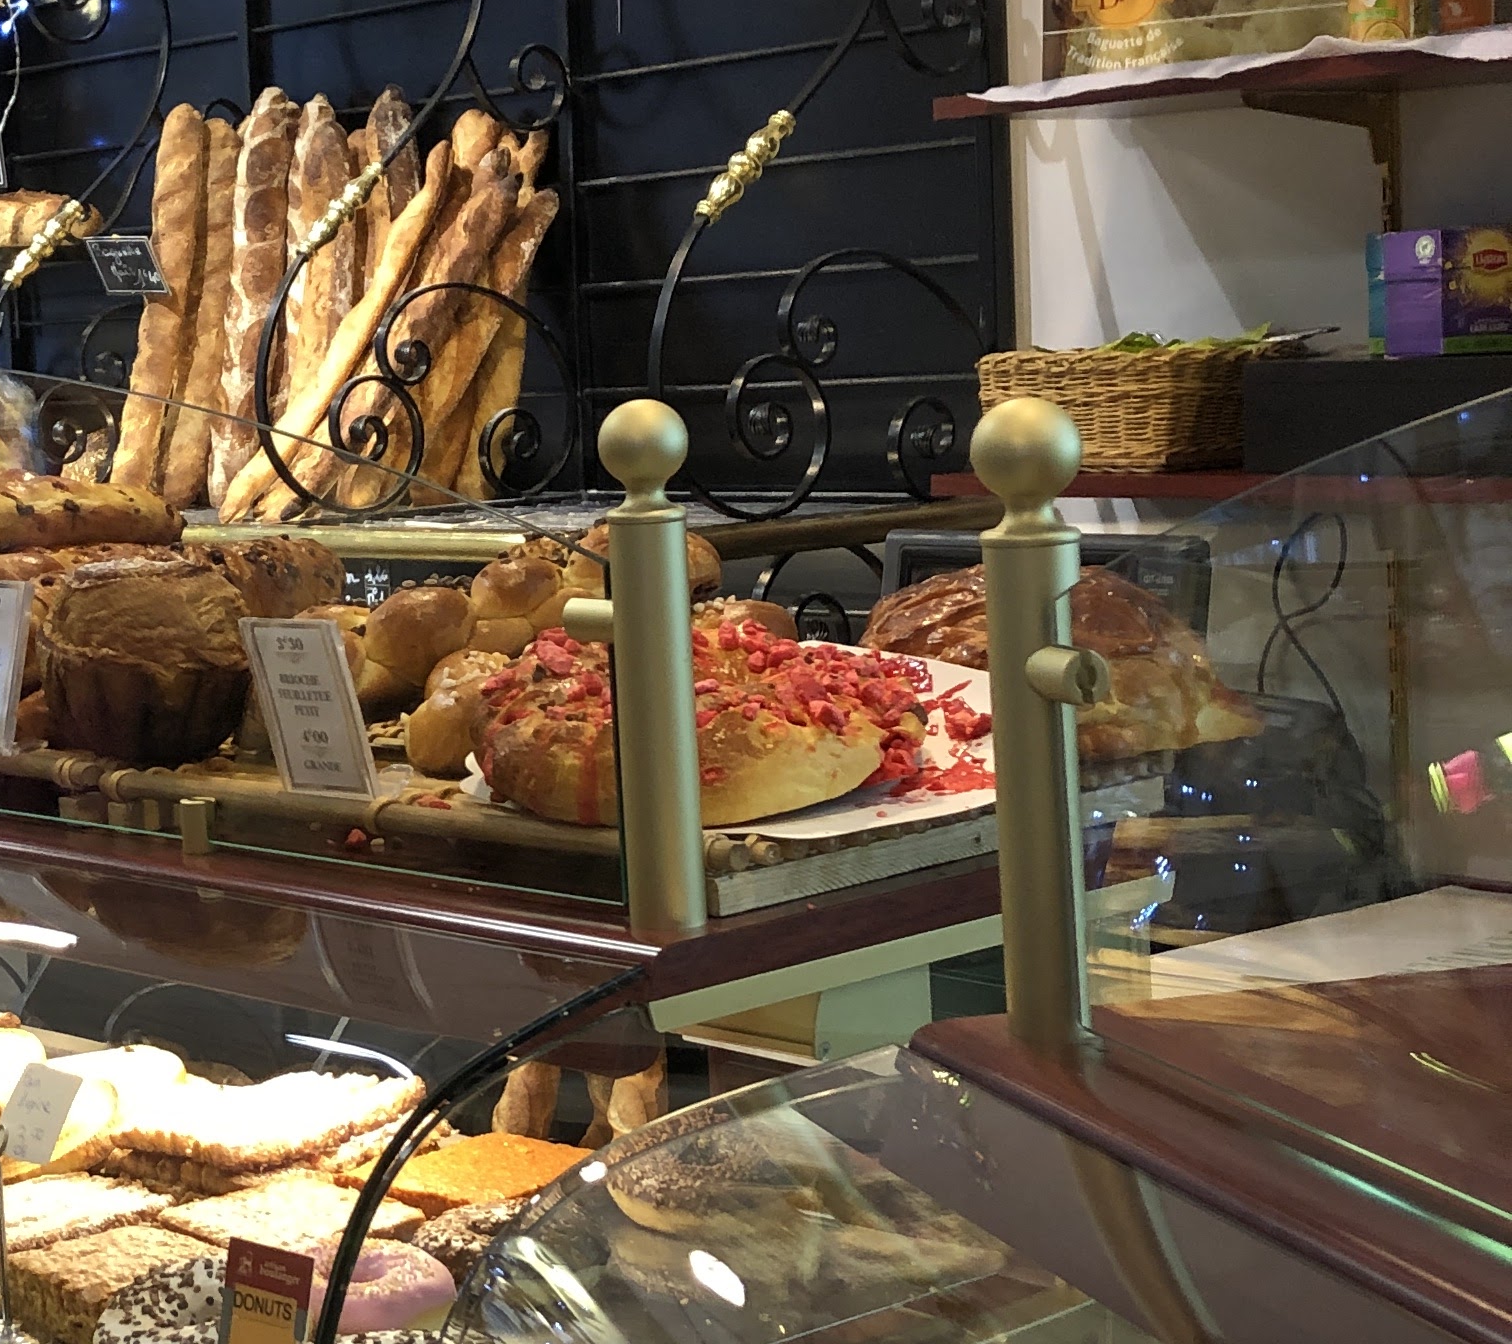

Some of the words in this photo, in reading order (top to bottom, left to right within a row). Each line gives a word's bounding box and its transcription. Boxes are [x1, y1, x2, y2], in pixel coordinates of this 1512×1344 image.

[1087, 32, 1143, 52] Baguette
[1146, 28, 1162, 42] de
[1068, 45, 1122, 69] Tradition
[304, 759, 342, 773] GRANDE
[233, 1290, 293, 1322] DONUTS
